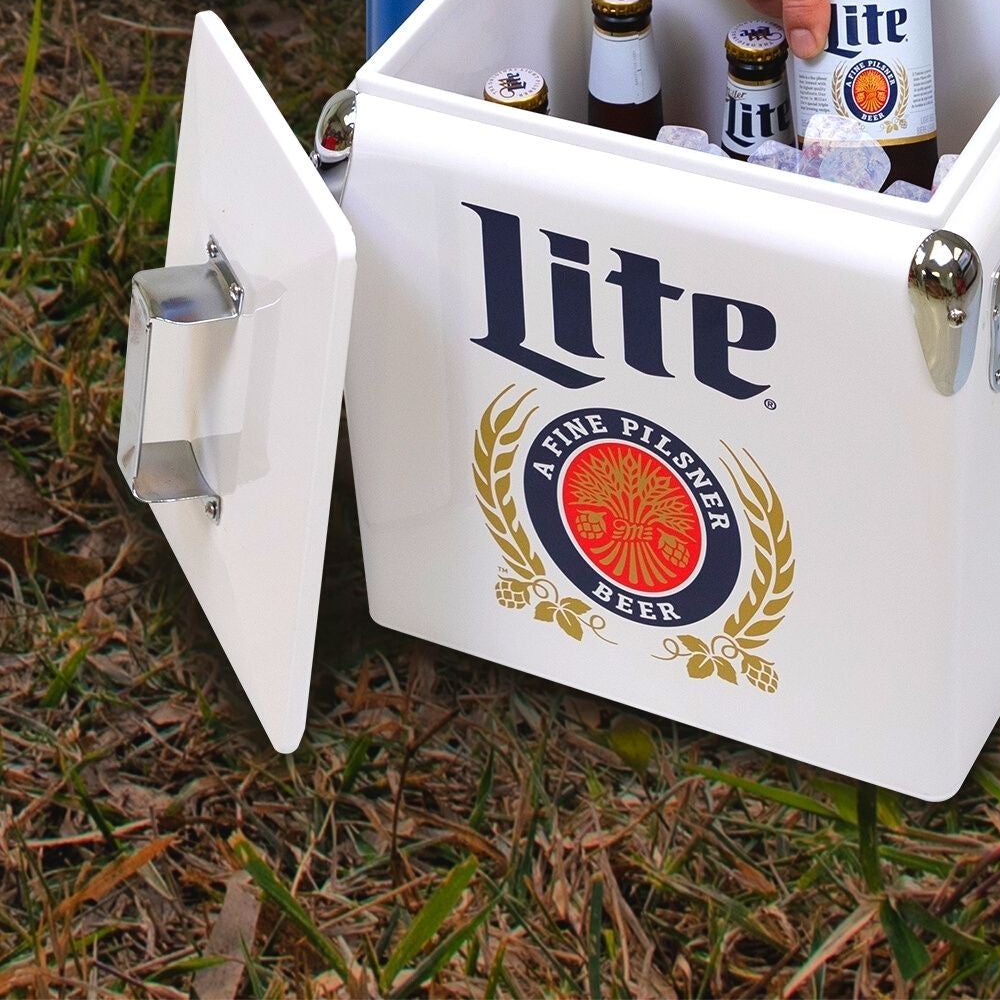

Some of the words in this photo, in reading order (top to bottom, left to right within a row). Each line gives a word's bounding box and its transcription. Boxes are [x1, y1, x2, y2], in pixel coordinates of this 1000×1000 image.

[824, 3, 908, 59] Lite
[845, 80, 852, 88] A
[848, 62, 866, 80] FINE
[867, 60, 896, 86] PILSNER
[725, 96, 790, 148] Lite
[861, 112, 885, 122] BEER
[460, 201, 777, 400] Lite
[541, 414, 608, 458] FINE
[532, 461, 556, 481] A
[620, 416, 731, 530] PILSNER
[591, 581, 682, 621] BEER
